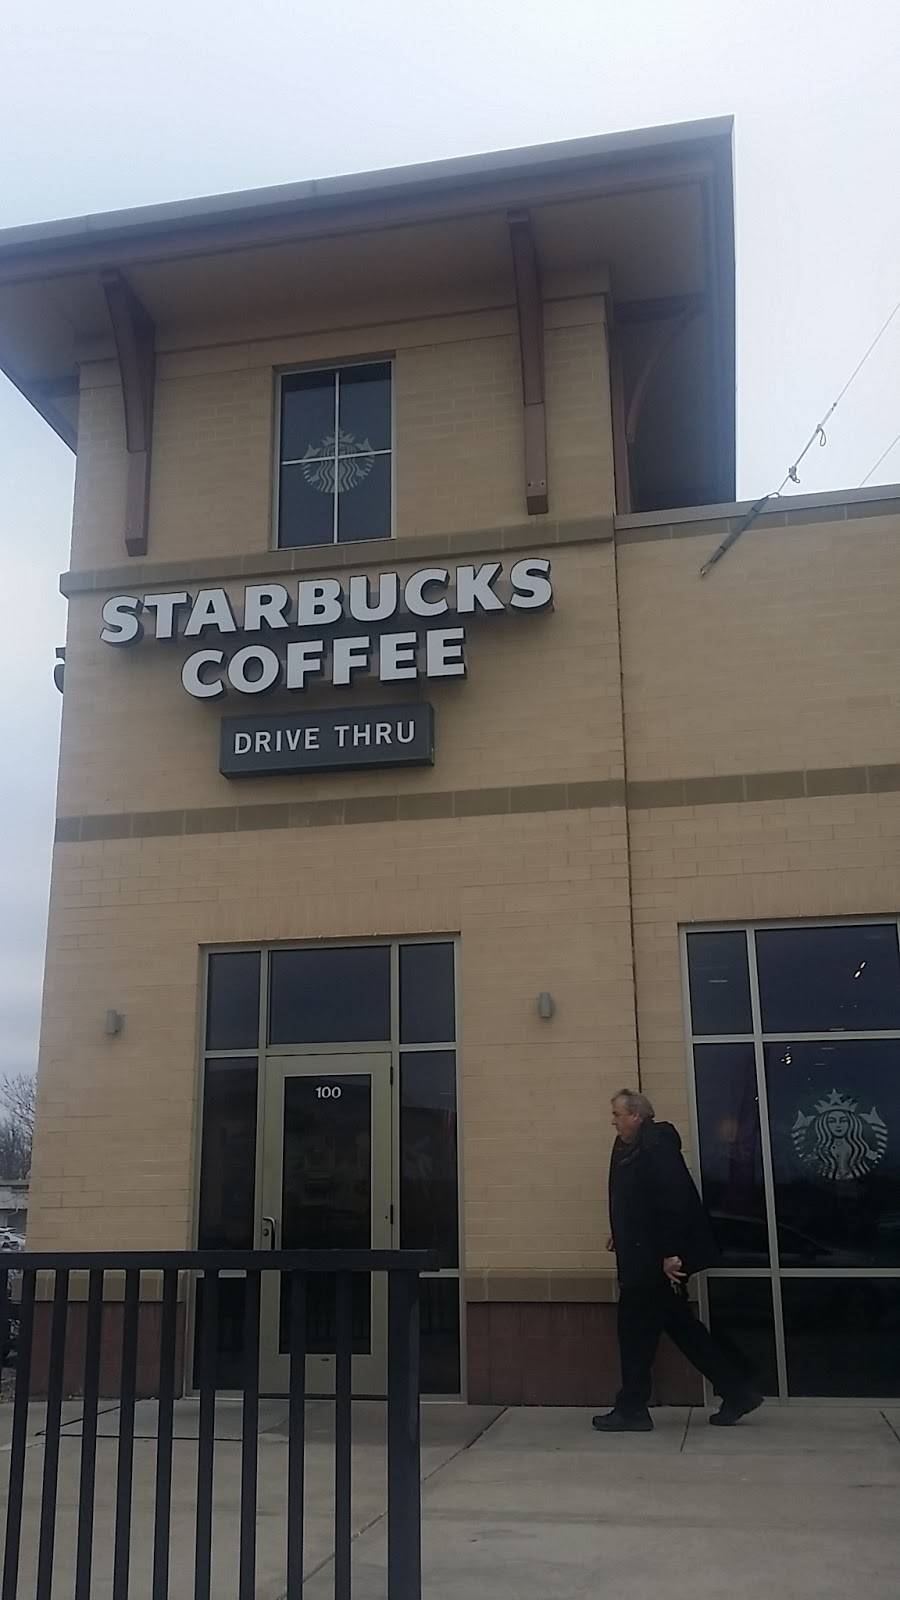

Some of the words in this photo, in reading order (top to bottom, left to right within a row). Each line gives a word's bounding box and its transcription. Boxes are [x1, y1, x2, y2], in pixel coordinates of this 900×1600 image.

[100, 558, 553, 644] STARBUCKS
[181, 627, 467, 698] COFFEE
[233, 726, 320, 755] DRIVE
[334, 720, 416, 748] THRU
[315, 1086, 342, 1099] 100
